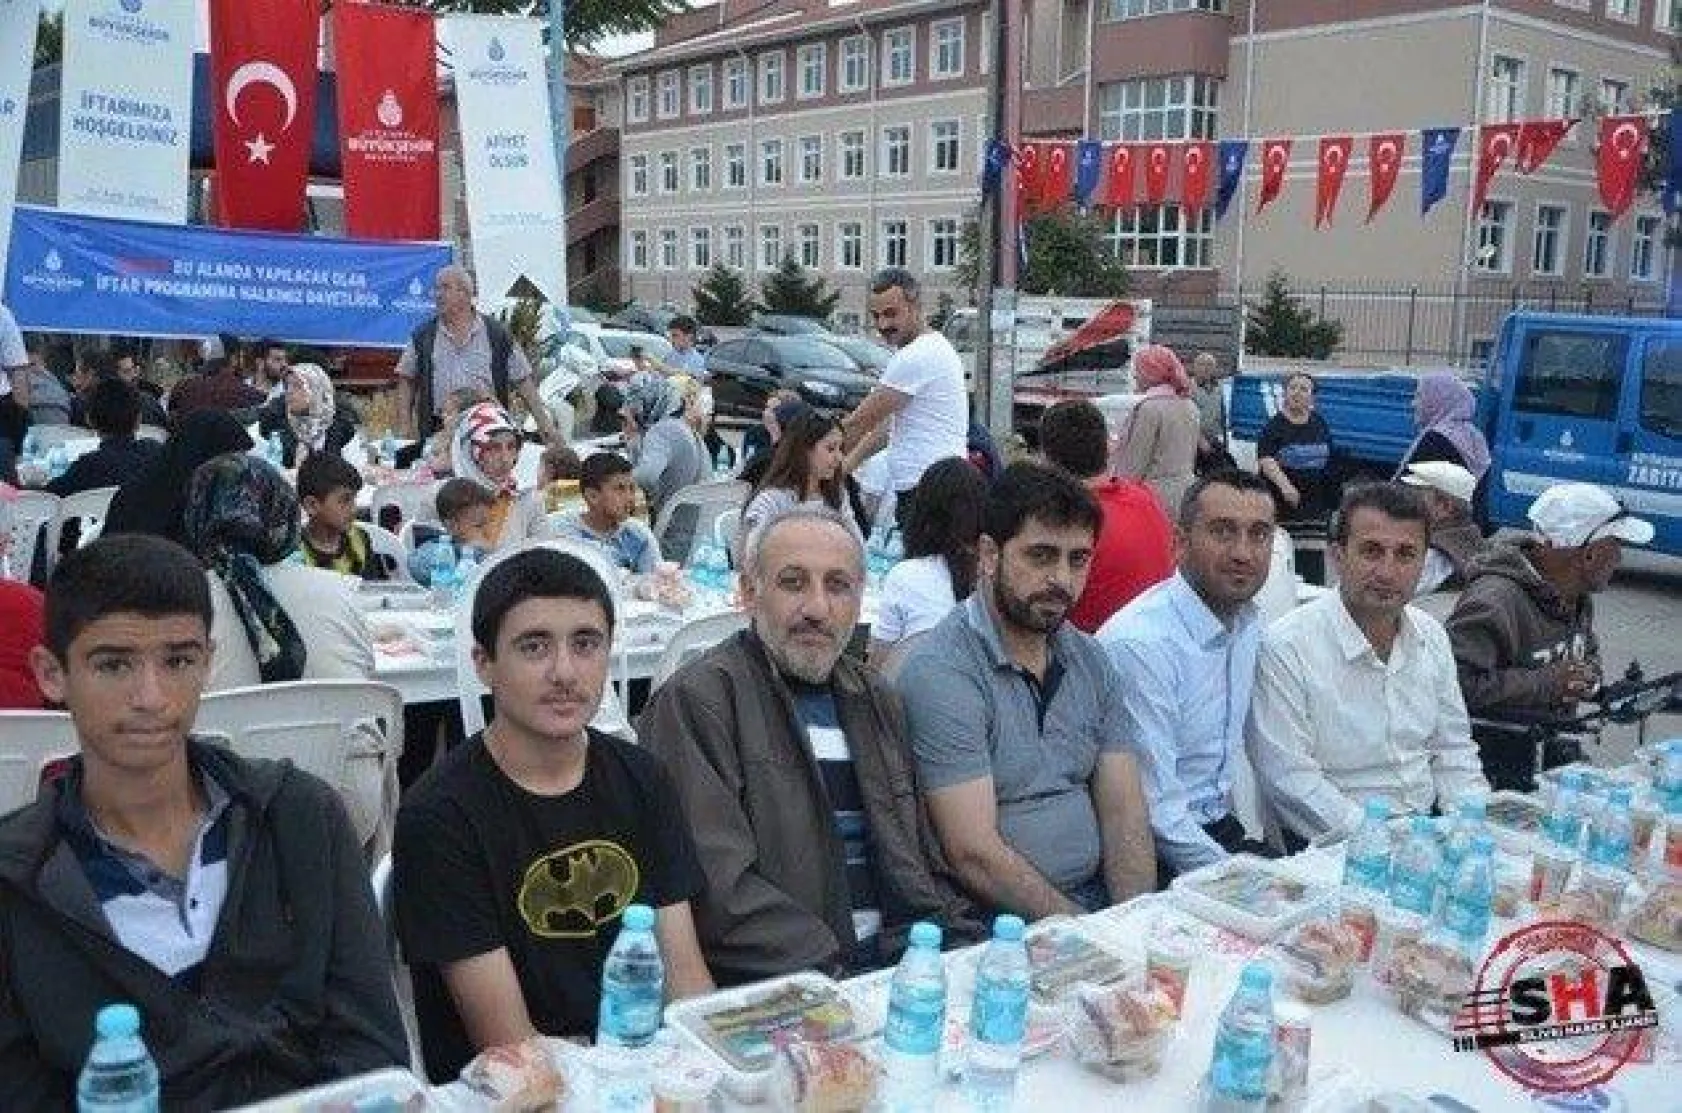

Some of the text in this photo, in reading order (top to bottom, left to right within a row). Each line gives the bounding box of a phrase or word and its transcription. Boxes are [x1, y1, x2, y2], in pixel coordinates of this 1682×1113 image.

[81, 89, 172, 122] İFTARIMIZA
[73, 116, 178, 146] HOŞGELDİNİZ
[96, 272, 140, 294] İFTAR
[144, 277, 236, 298] PROGRAMINA
[197, 262, 252, 280] ALANDA
